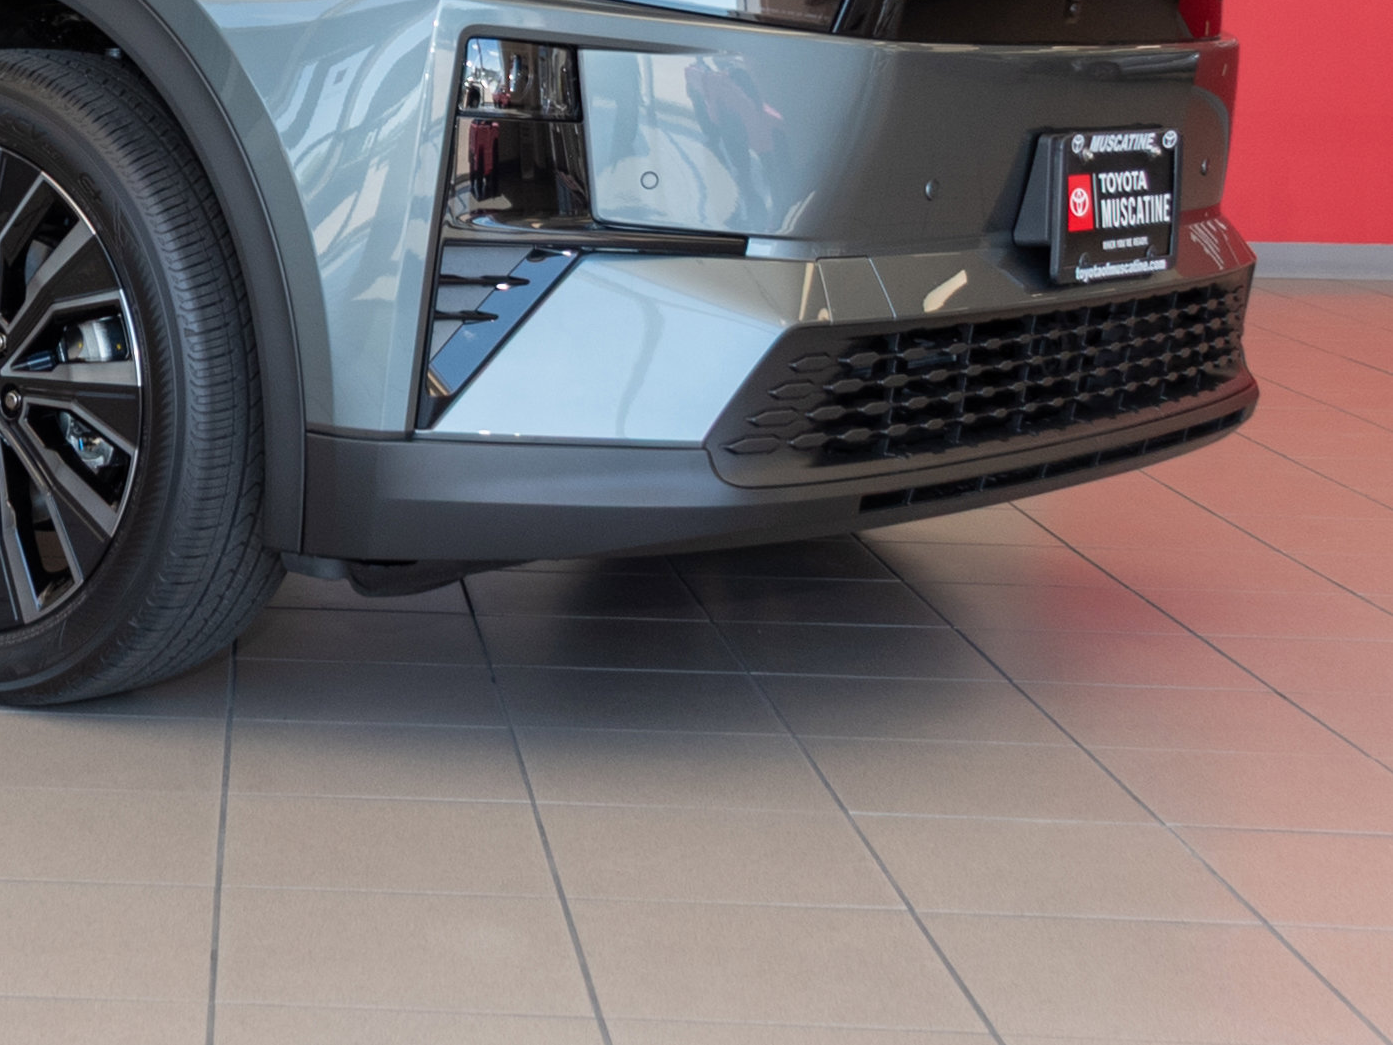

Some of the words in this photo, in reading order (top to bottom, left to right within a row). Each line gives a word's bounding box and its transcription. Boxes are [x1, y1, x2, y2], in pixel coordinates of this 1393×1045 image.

[1090, 132, 1156, 152] MUSCATINE
[1098, 170, 1148, 193] TOYOTA
[1101, 193, 1171, 229] MUSCATINE
[1075, 259, 1167, 283] toyotaofmuscatine.com
